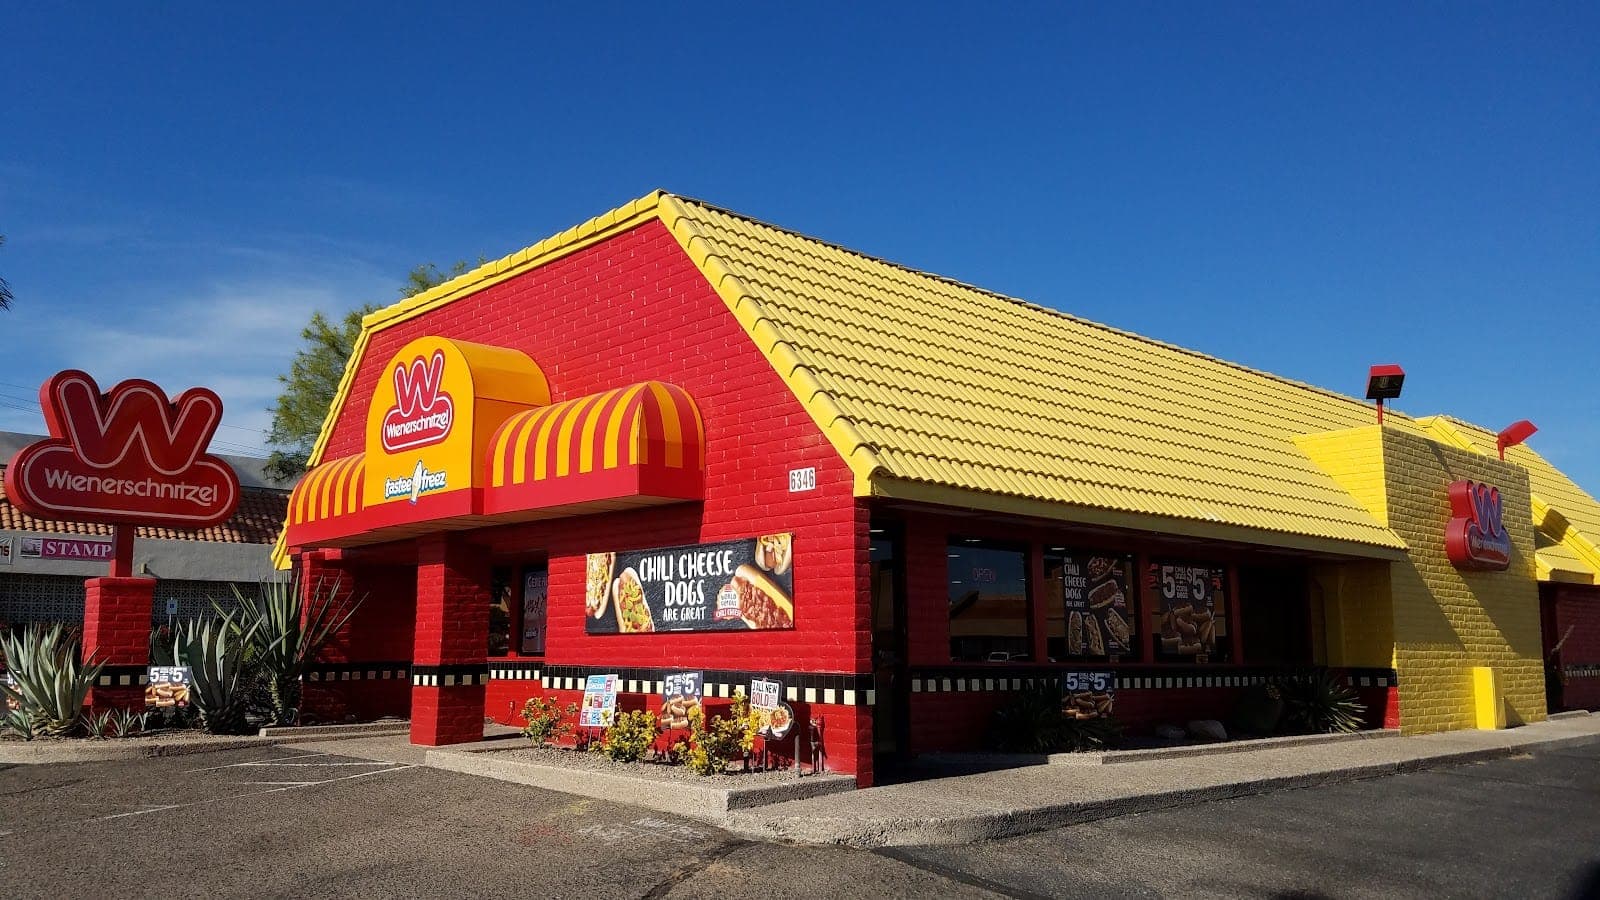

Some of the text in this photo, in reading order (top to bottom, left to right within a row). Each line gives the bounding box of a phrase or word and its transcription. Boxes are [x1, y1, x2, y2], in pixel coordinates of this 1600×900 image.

[395, 353, 443, 417] W
[60, 378, 217, 475] W
[386, 408, 449, 439] Wienerschnitzel
[44, 467, 218, 507] Wienerschnitzel
[385, 468, 447, 498] tastee freez
[790, 470, 814, 490] 6346
[639, 550, 734, 582] CHILI CHEESE
[664, 579, 705, 607] DOGS
[1065, 576, 1087, 588] CHEESE
[1065, 588, 1082, 600] DOGS
[1162, 565, 1175, 598] 5
[663, 605, 707, 621] ARE GREAT
[150, 667, 160, 683] 5
[665, 675, 674, 696] 5
[1066, 672, 1079, 691] 5
